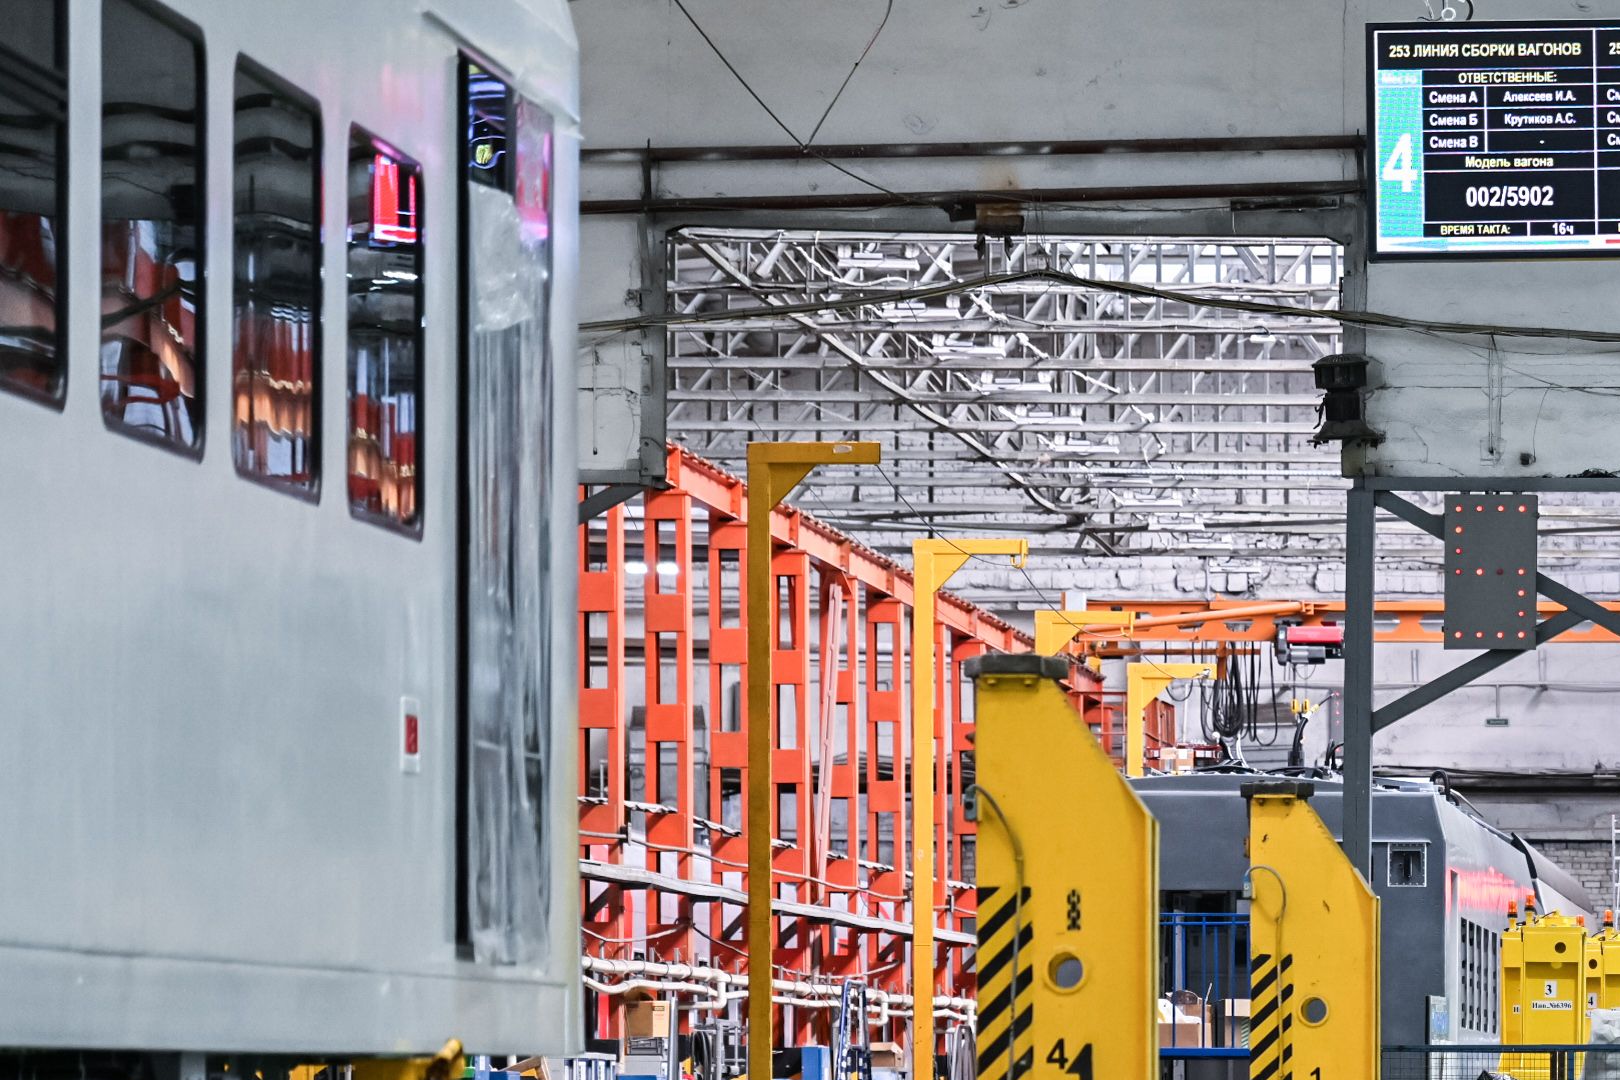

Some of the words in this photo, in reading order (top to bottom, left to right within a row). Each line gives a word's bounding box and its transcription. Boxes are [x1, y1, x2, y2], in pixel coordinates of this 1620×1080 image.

[1388, 45, 1411, 58] 253
[1413, 44, 1458, 58] ЛИНИЯ
[1461, 43, 1515, 57] СБОРКИ
[1517, 42, 1582, 56] ВАГОНОВ
[1458, 71, 1558, 84] ОТВЕТСТВЕННЫЕ:
[1429, 91, 1466, 103] Смена
[1468, 91, 1478, 103] А
[1503, 91, 1553, 102] Алексеев
[1555, 90, 1577, 101] И.А.
[1429, 114, 1466, 126] Смена
[1468, 113, 1478, 125] Б
[1504, 113, 1553, 127] Крутиков
[1555, 112, 1577, 124] А.С.
[1429, 136, 1467, 148] Смена
[1469, 136, 1479, 148] В
[1382, 132, 1418, 192] 4
[1465, 156, 1511, 168] Модель
[1514, 157, 1554, 167] вагона
[1465, 186, 1554, 207] 002/5902
[1440, 225, 1474, 235] ВРЕМЯ
[1477, 224, 1511, 235] ТАКТА:
[1552, 222, 1574, 235] 16ч
[1545, 984, 1553, 995] 3
[1588, 996, 1594, 1006] 4
[1046, 1038, 1068, 1070] 4
